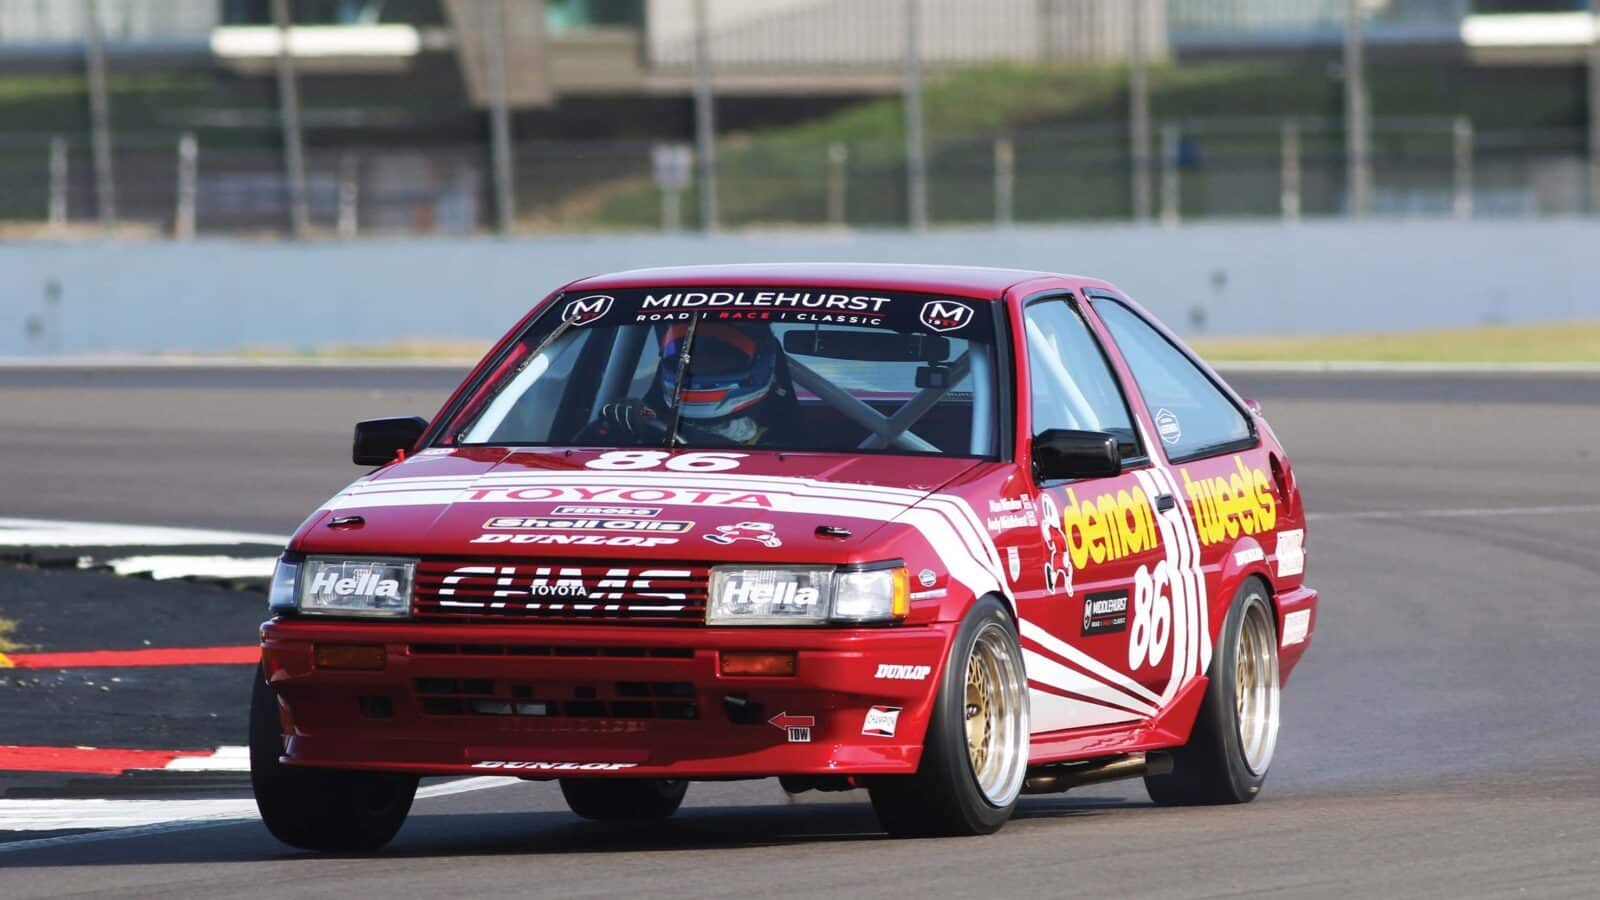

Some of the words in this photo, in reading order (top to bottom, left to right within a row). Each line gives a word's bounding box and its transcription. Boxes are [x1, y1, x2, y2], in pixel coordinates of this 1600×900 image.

[641, 291, 892, 312] MIDDLEHURST
[636, 312, 690, 322] ROAD
[718, 311, 771, 320] RACE
[796, 313, 882, 326] CLASSIC
[929, 303, 965, 321] M
[584, 450, 750, 472] 86
[468, 487, 774, 508] TOYOTA
[1180, 455, 1277, 547] tweeks
[492, 519, 601, 529] Shell
[1064, 487, 1159, 570] demon
[469, 533, 680, 547] DUNLOP
[310, 572, 400, 597] Hella
[529, 585, 588, 597] TOYOTA
[722, 581, 819, 606] Hella
[1128, 560, 1171, 671] 86
[874, 664, 932, 680] DUNLOP
[789, 728, 810, 741] TOW
[471, 760, 639, 770] DUNLOP
